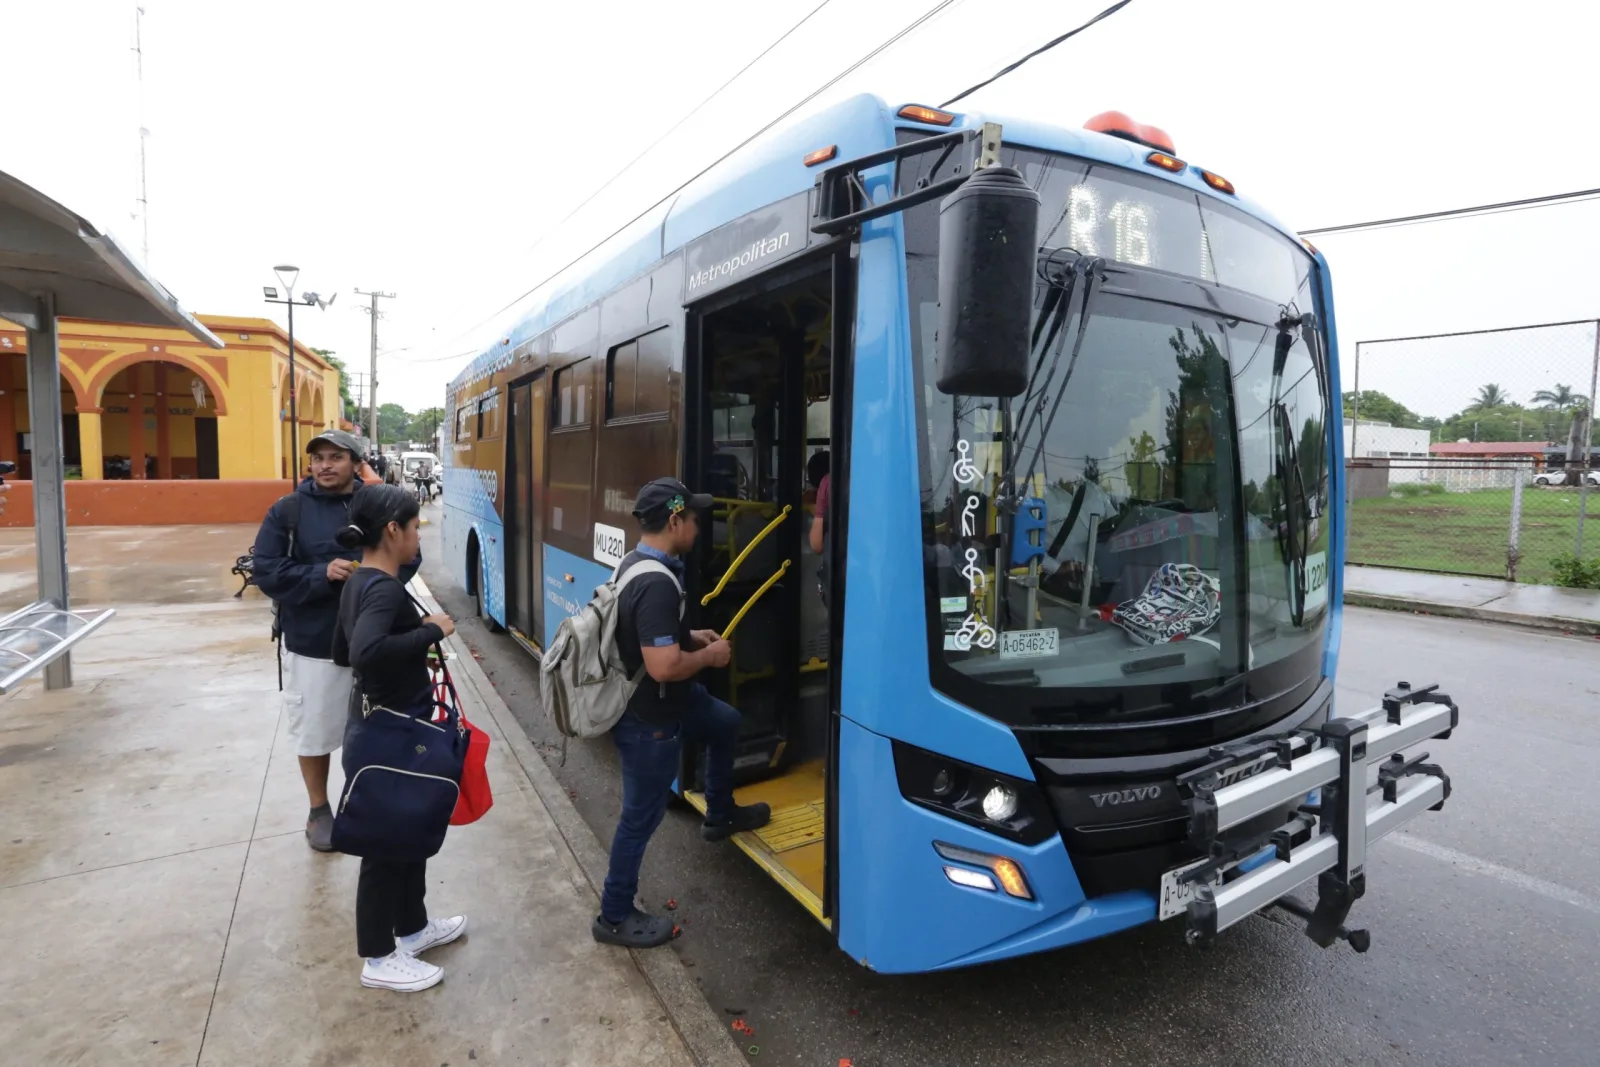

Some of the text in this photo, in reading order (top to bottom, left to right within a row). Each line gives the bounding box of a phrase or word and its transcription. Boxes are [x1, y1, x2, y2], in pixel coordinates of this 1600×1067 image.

[1107, 202, 1150, 265] 16
[688, 231, 790, 291] Metropolitan
[595, 532, 623, 559] MU 220
[1003, 636, 1055, 653] A-05462-Z
[1089, 785, 1162, 808] VOLVO
